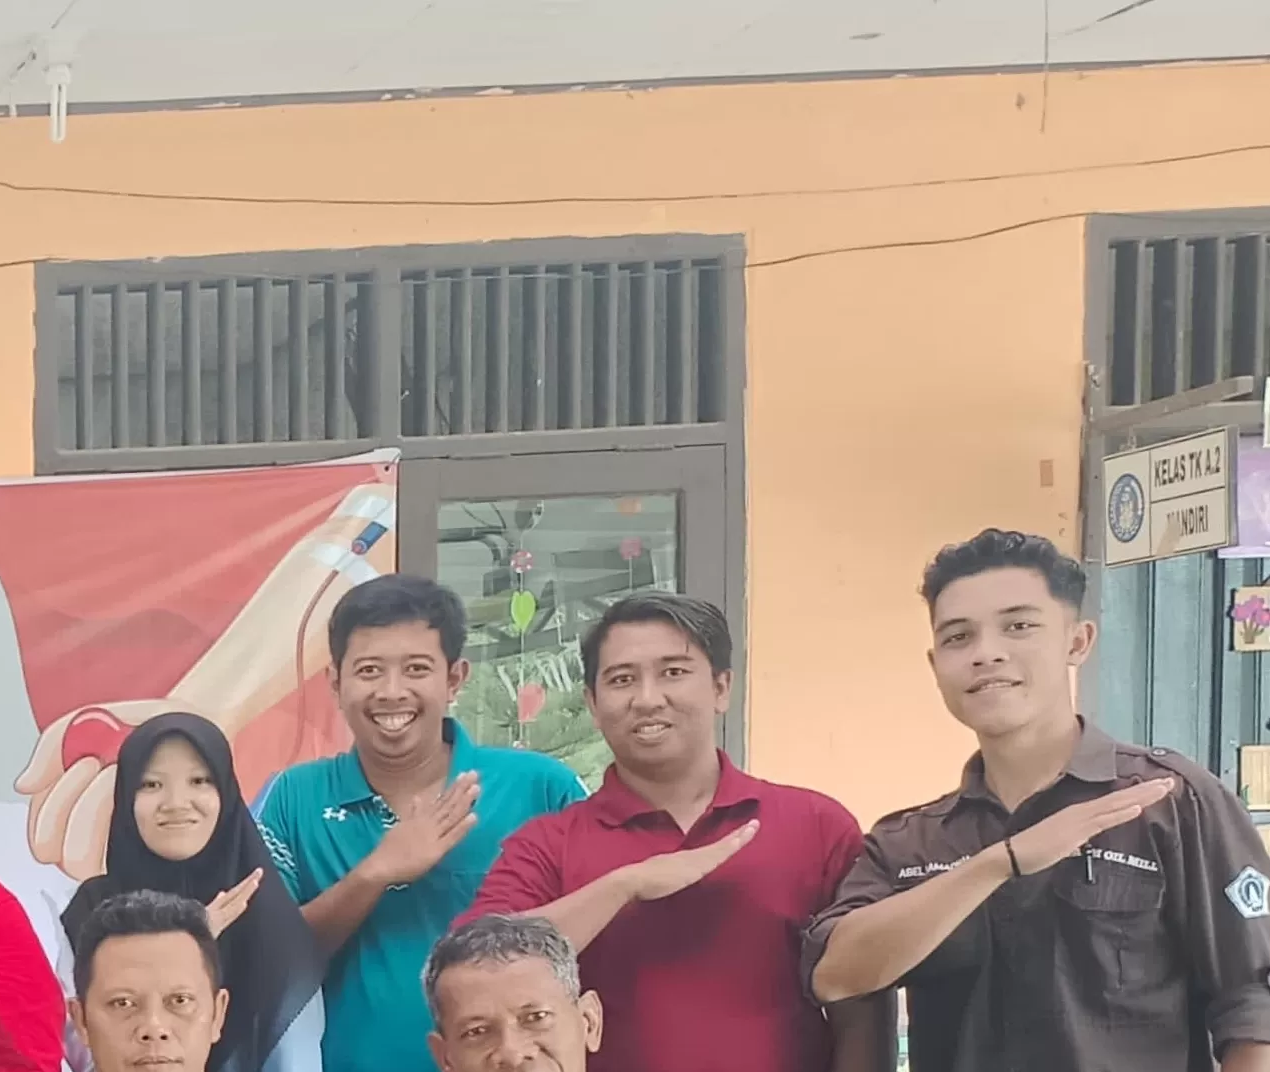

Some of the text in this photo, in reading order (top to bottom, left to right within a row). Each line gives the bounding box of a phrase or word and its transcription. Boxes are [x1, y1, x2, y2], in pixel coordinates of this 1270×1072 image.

[1153, 454, 1186, 488] KELAS
[1188, 450, 1203, 480] TK
[1166, 504, 1209, 537] NDIRI
[1103, 851, 1126, 863] OIL
[1127, 854, 1159, 872] MILL
